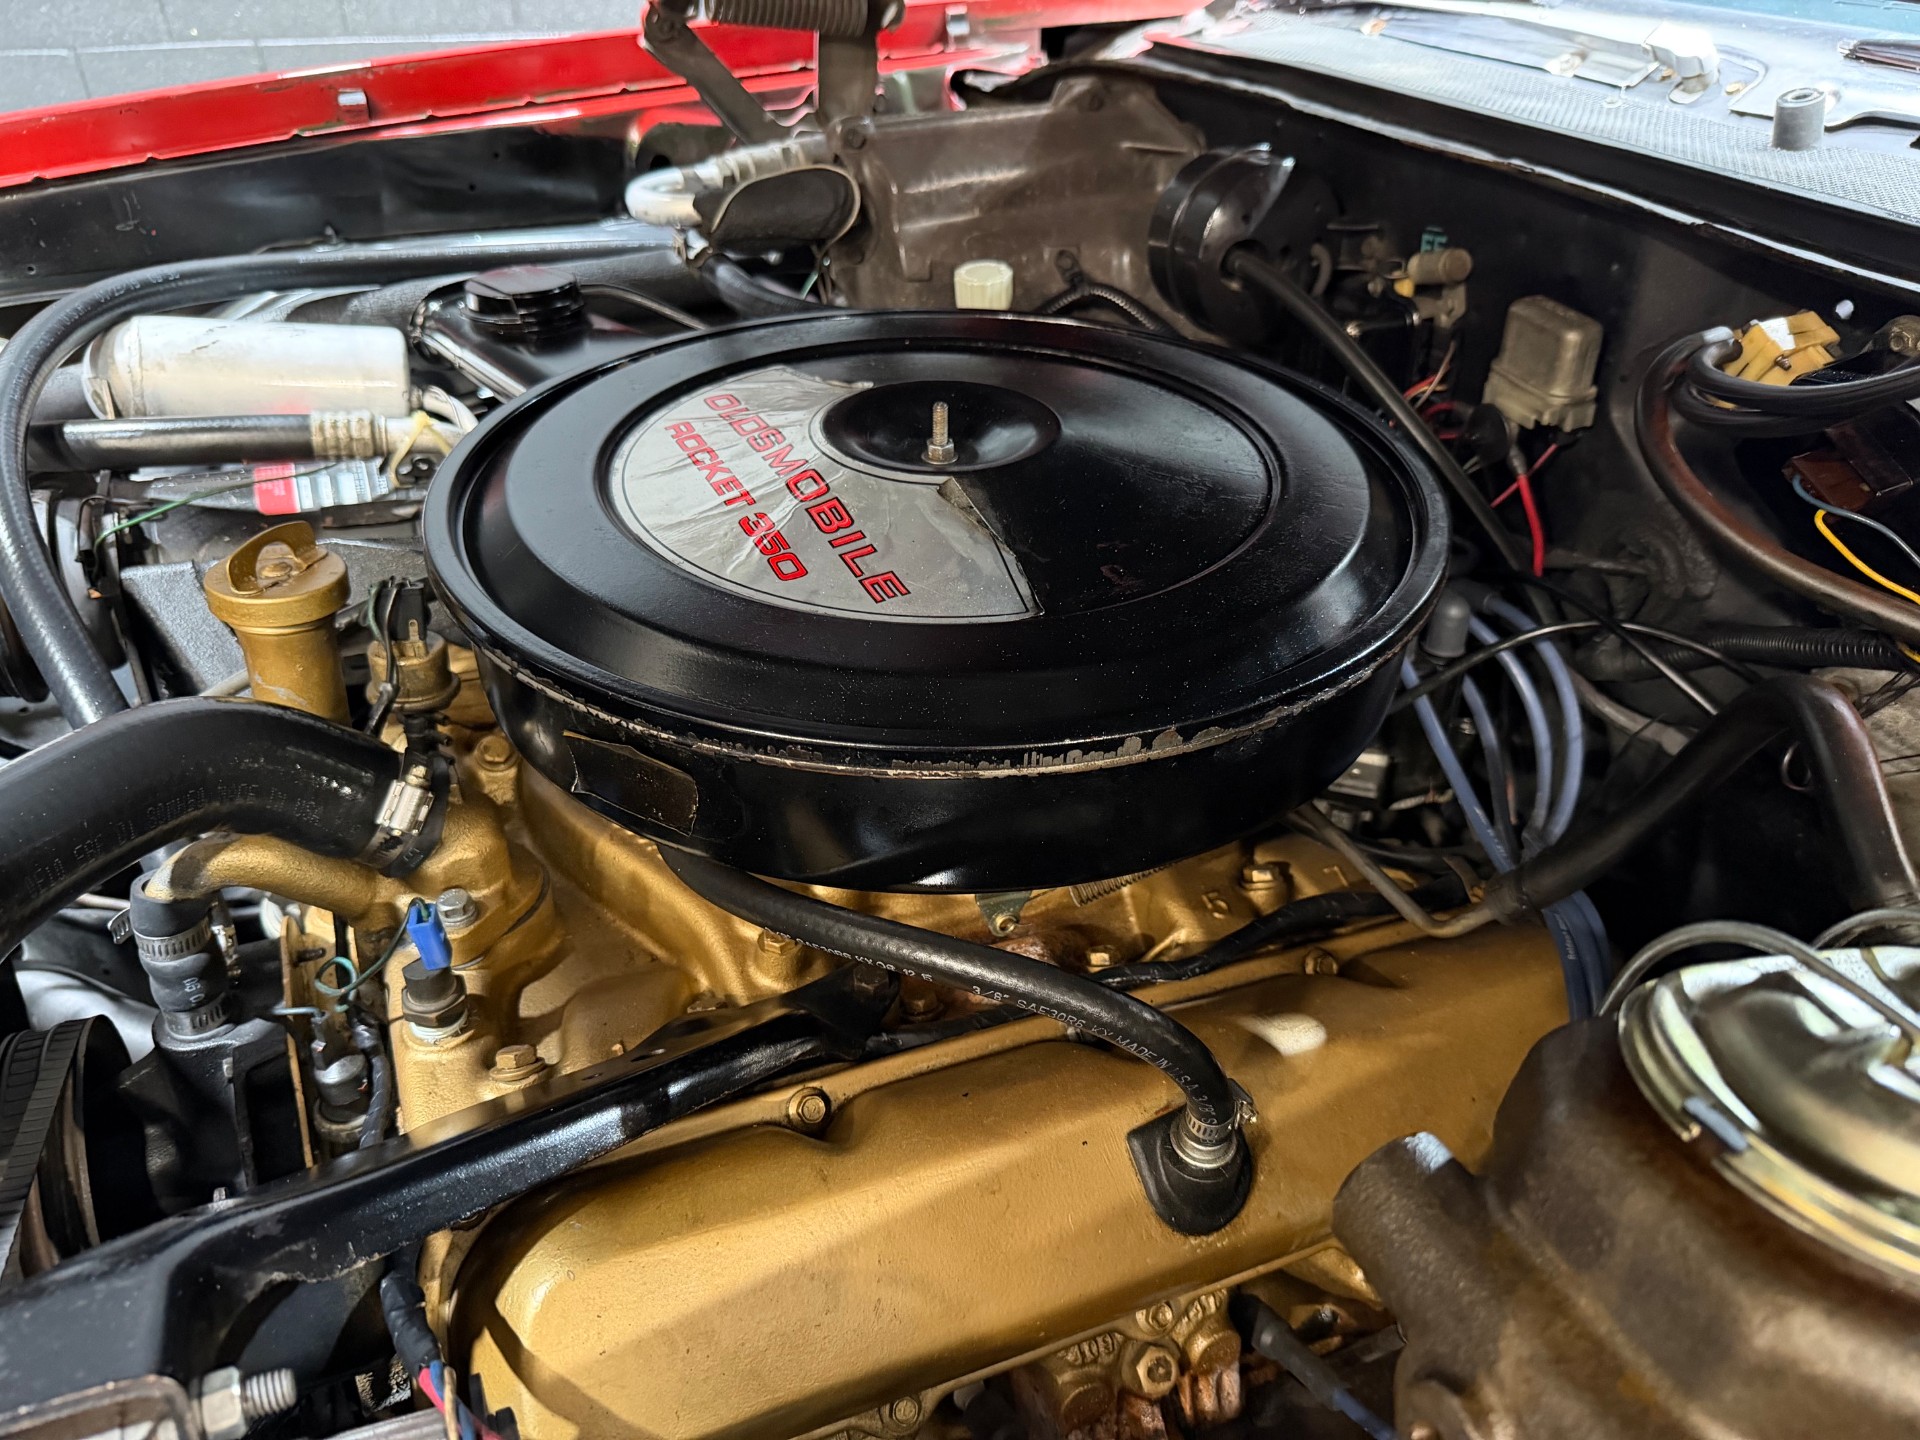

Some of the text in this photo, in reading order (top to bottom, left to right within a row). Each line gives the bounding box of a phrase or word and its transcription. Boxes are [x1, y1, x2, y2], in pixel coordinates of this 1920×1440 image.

[664, 421, 809, 582] ROCKET 350
[703, 393, 912, 604] OLDSMOBILE
[972, 985, 1010, 1001] 3/8"
[1016, 999, 1086, 1029] SAE30R6
[1115, 1035, 1158, 1061] MADE
[1156, 1057, 1173, 1070] IN
